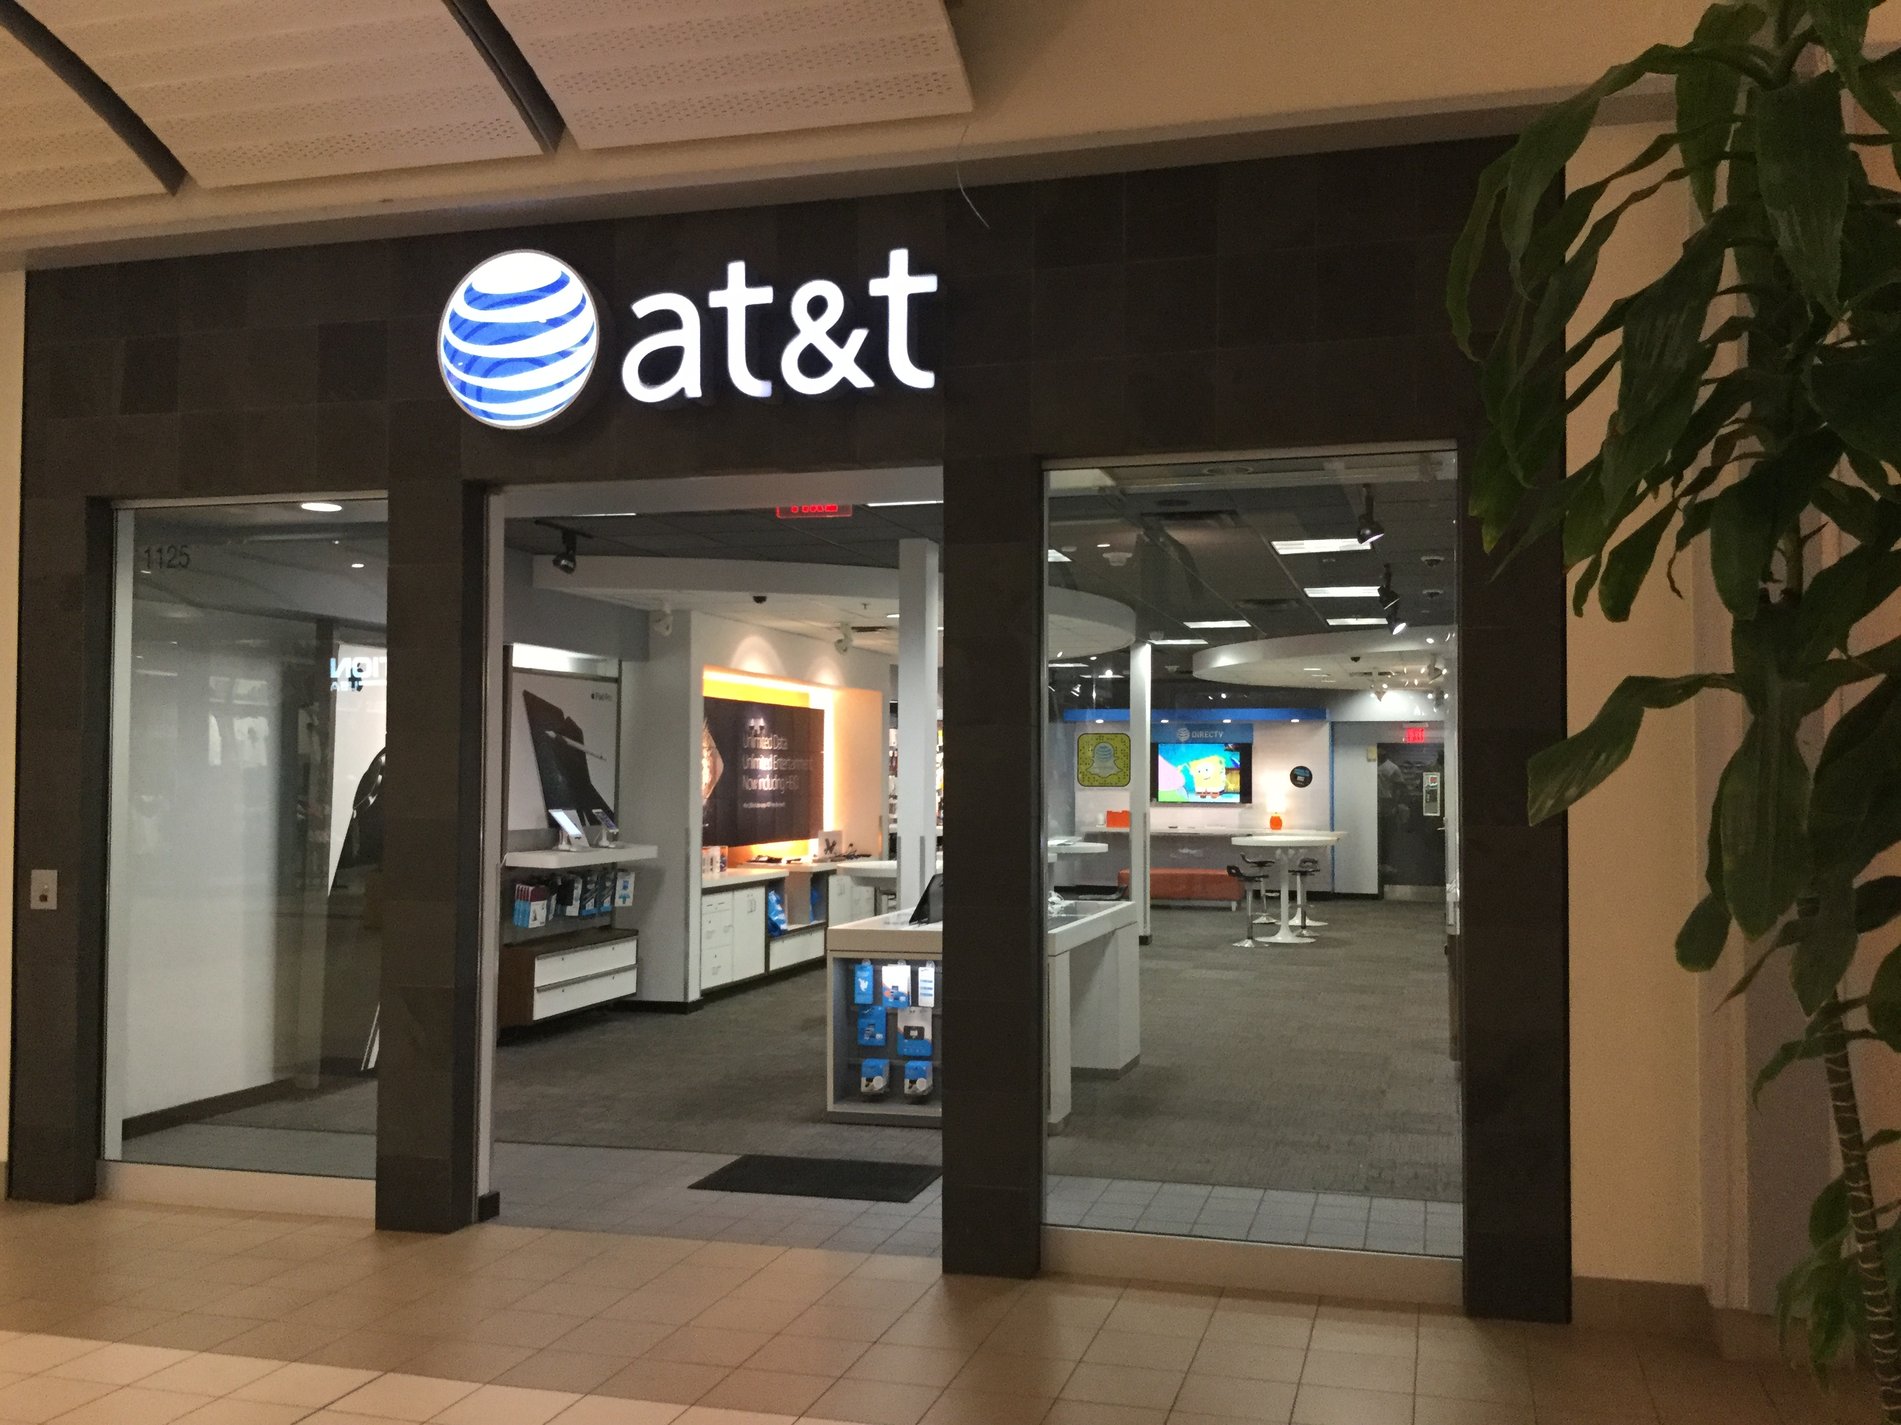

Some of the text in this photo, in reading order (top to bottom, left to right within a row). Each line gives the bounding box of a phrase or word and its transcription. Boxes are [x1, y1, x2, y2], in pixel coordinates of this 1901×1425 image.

[621, 248, 938, 404] at&t
[144, 544, 191, 569] 1125
[743, 733, 788, 750] Unlimited Data
[743, 754, 773, 770] Unlimited
